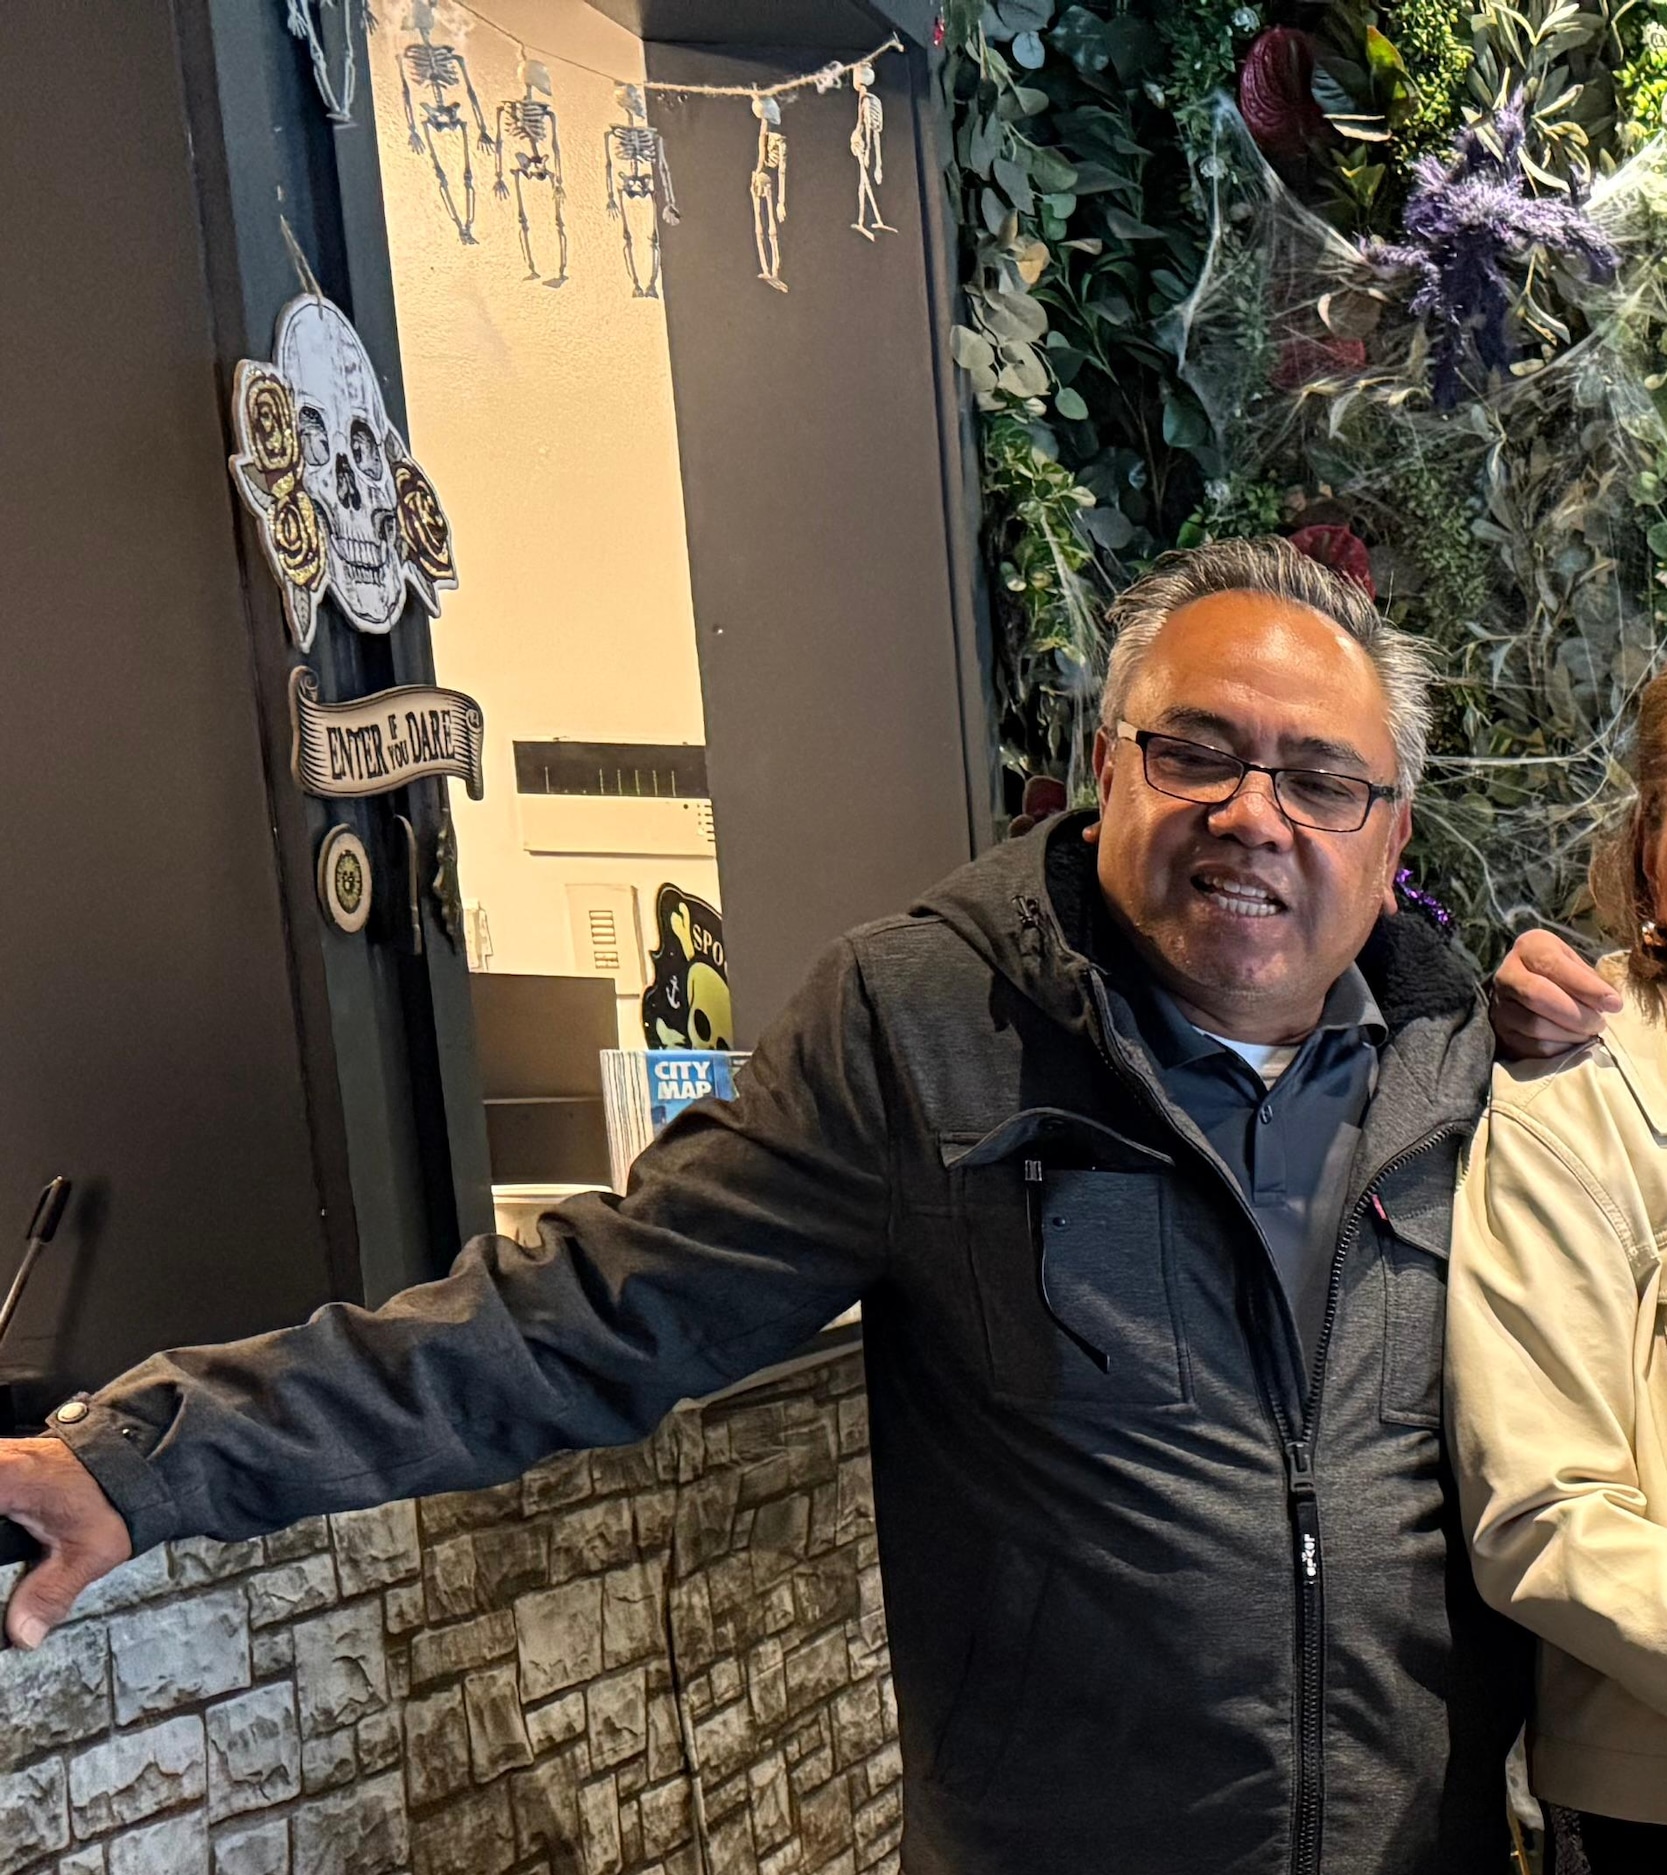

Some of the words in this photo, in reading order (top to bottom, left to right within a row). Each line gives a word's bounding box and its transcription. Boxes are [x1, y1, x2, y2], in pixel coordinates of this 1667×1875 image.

[388, 714, 399, 740] IF
[405, 709, 455, 764] DARE
[326, 723, 390, 781] ENTER
[387, 740, 409, 770] YOU
[692, 922, 729, 976] SPO
[654, 1060, 711, 1080] CITY
[657, 1080, 712, 1100] MAP
